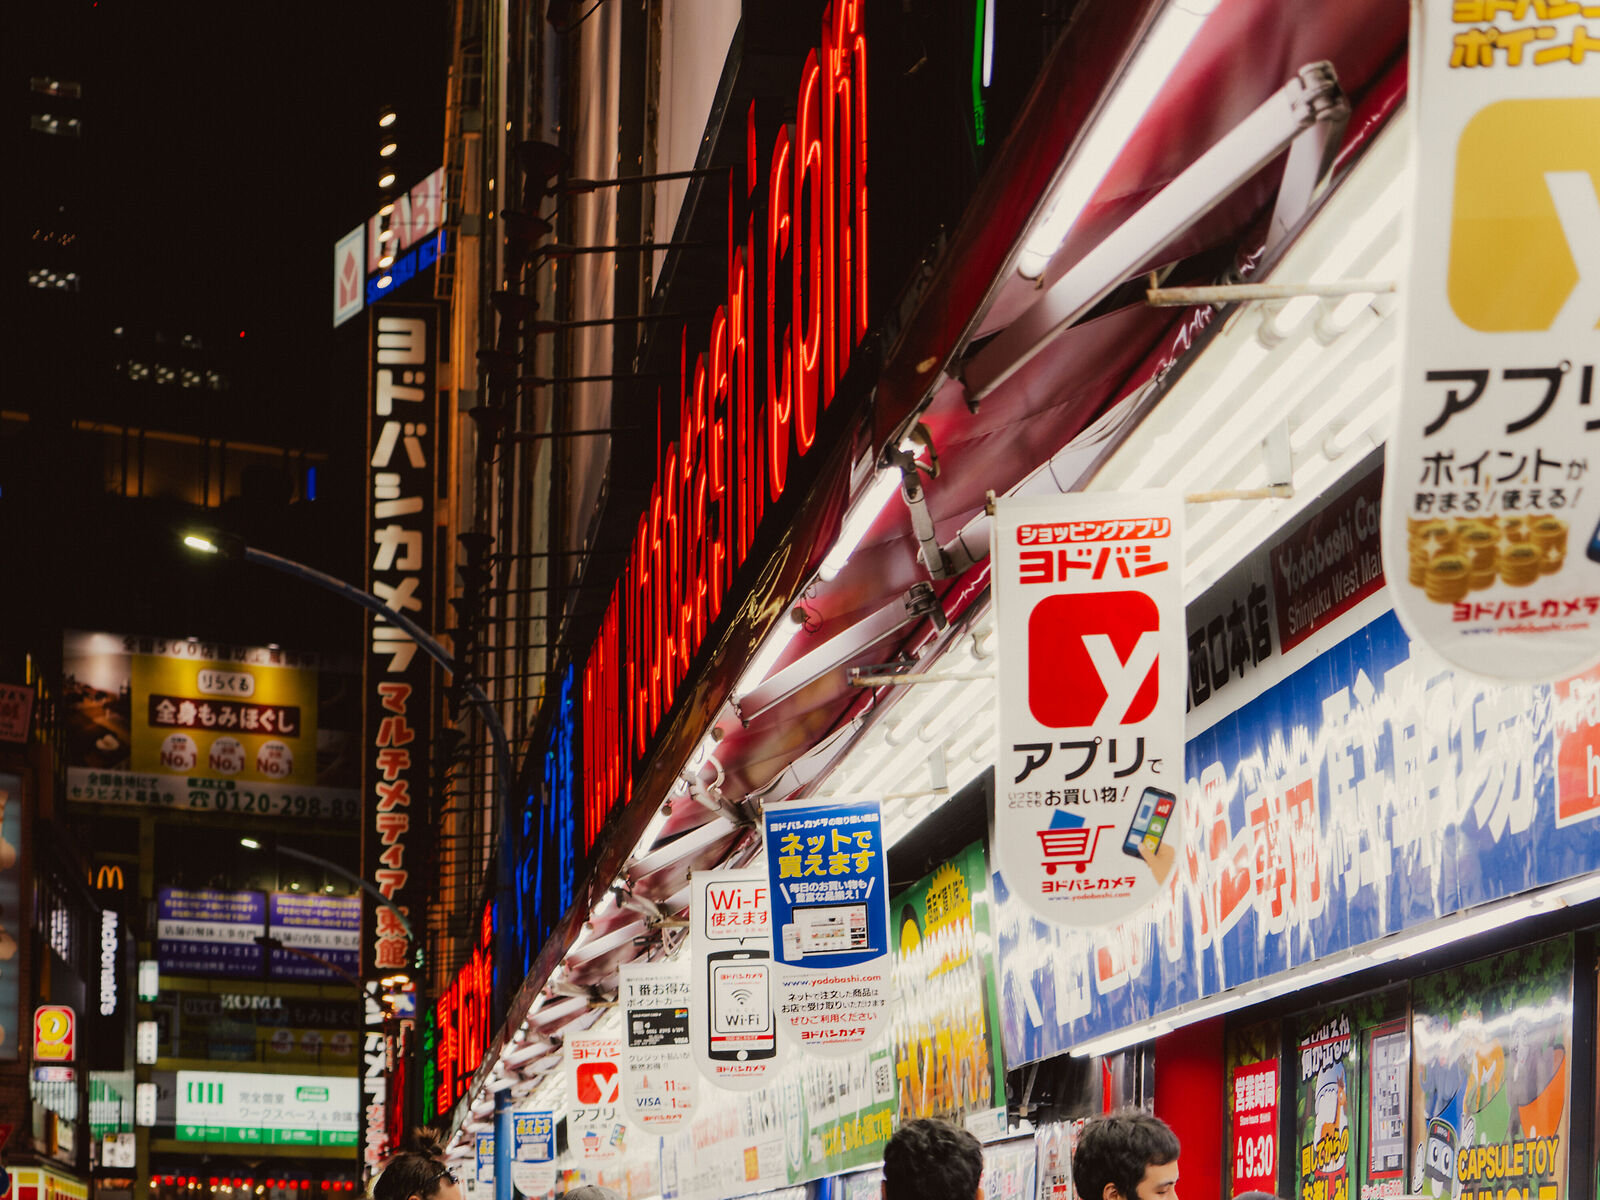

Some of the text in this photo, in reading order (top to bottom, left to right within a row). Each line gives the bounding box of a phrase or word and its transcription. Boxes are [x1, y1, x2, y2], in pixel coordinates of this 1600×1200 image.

[1420, 449, 1588, 486] ポイントが
[371, 316, 427, 672] ヨドバシカメラ
[1021, 519, 1169, 544] ショッピングアプリ
[1279, 496, 1381, 597] Yodobashi Ca
[1019, 545, 1168, 584] ヨドバシ
[1288, 545, 1382, 635] Shinjuku West Mai
[202, 673, 250, 693] りらくる
[155, 698, 295, 733] 全身もみほぐし
[161, 752, 197, 768] No.1
[209, 755, 245, 771] No.1
[256, 758, 293, 774] No.1
[1013, 736, 1163, 784] アプリで
[1044, 786, 1129, 806] お買い物!
[376, 682, 415, 969] マルチメディア東館
[780, 829, 873, 856] ネットで
[778, 850, 875, 879] 買えます
[1041, 876, 1136, 893] ヨドバシカメラ
[710, 888, 767, 911] Wi-F
[628, 983, 689, 996] 1番お得な
[783, 975, 881, 987] www.yodobashi.com
[781, 1000, 885, 1013] お店で受け取りいただけます
[788, 988, 878, 1002] ネットで注文した商品は
[790, 1012, 877, 1026] ぜひご利用ください
[801, 1027, 865, 1039] ヨドバシカメラ
[572, 1048, 621, 1060] ヨドバシ
[715, 1065, 766, 1073] ヨドバシカメラ
[636, 1097, 661, 1107] VISA
[1236, 1071, 1275, 1112] 営業時間
[1245, 1134, 1273, 1178] 9:30
[1302, 1129, 1350, 1177] 回してからの
[1457, 1138, 1559, 1182] CAPSULE TOY
